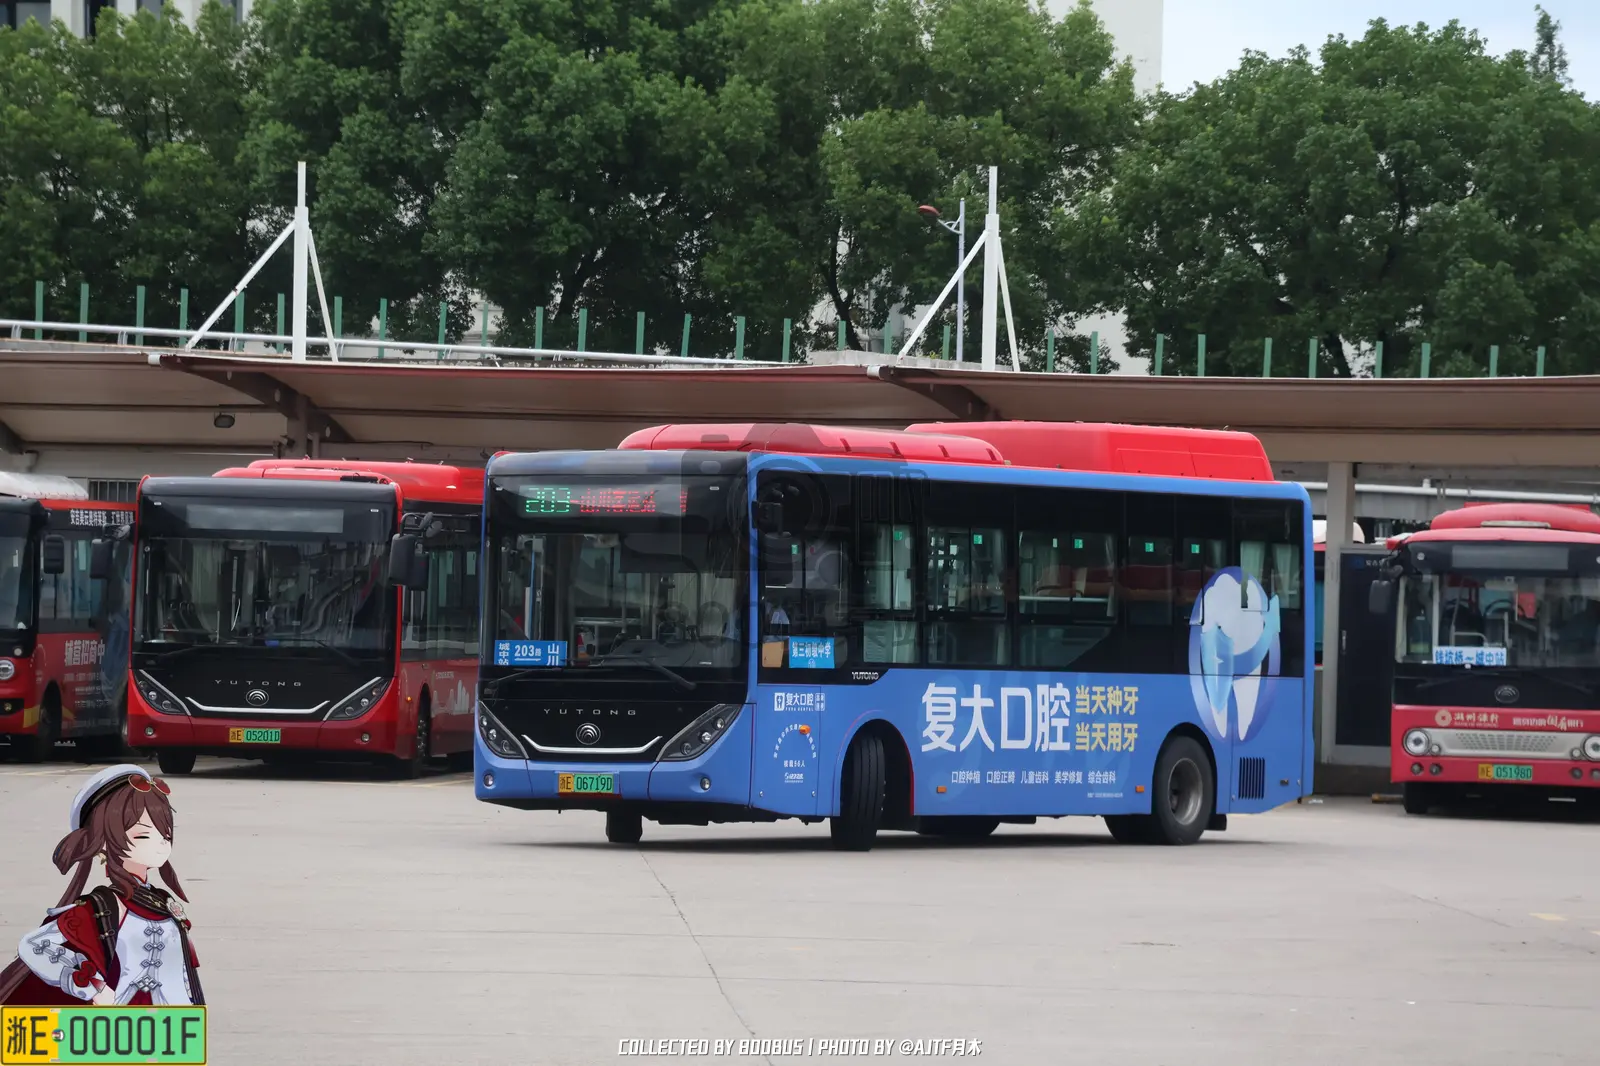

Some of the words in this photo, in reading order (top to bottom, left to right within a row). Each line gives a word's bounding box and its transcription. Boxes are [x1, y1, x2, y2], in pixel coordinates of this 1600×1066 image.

[525, 487, 570, 512] 203
[786, 692, 814, 706] 复大口腔
[1075, 685, 1139, 716] 当天种牙
[543, 708, 636, 716] YUTONG
[921, 683, 1071, 753] 复大口腔
[1075, 722, 1138, 752] 当天用牙
[951, 770, 981, 784] 口腔种植
[986, 770, 1016, 784] 口腔正畸
[1020, 770, 1049, 784] 儿童齿科
[1054, 770, 1083, 784] 美学修复
[1087, 770, 1117, 784] 综合齿科
